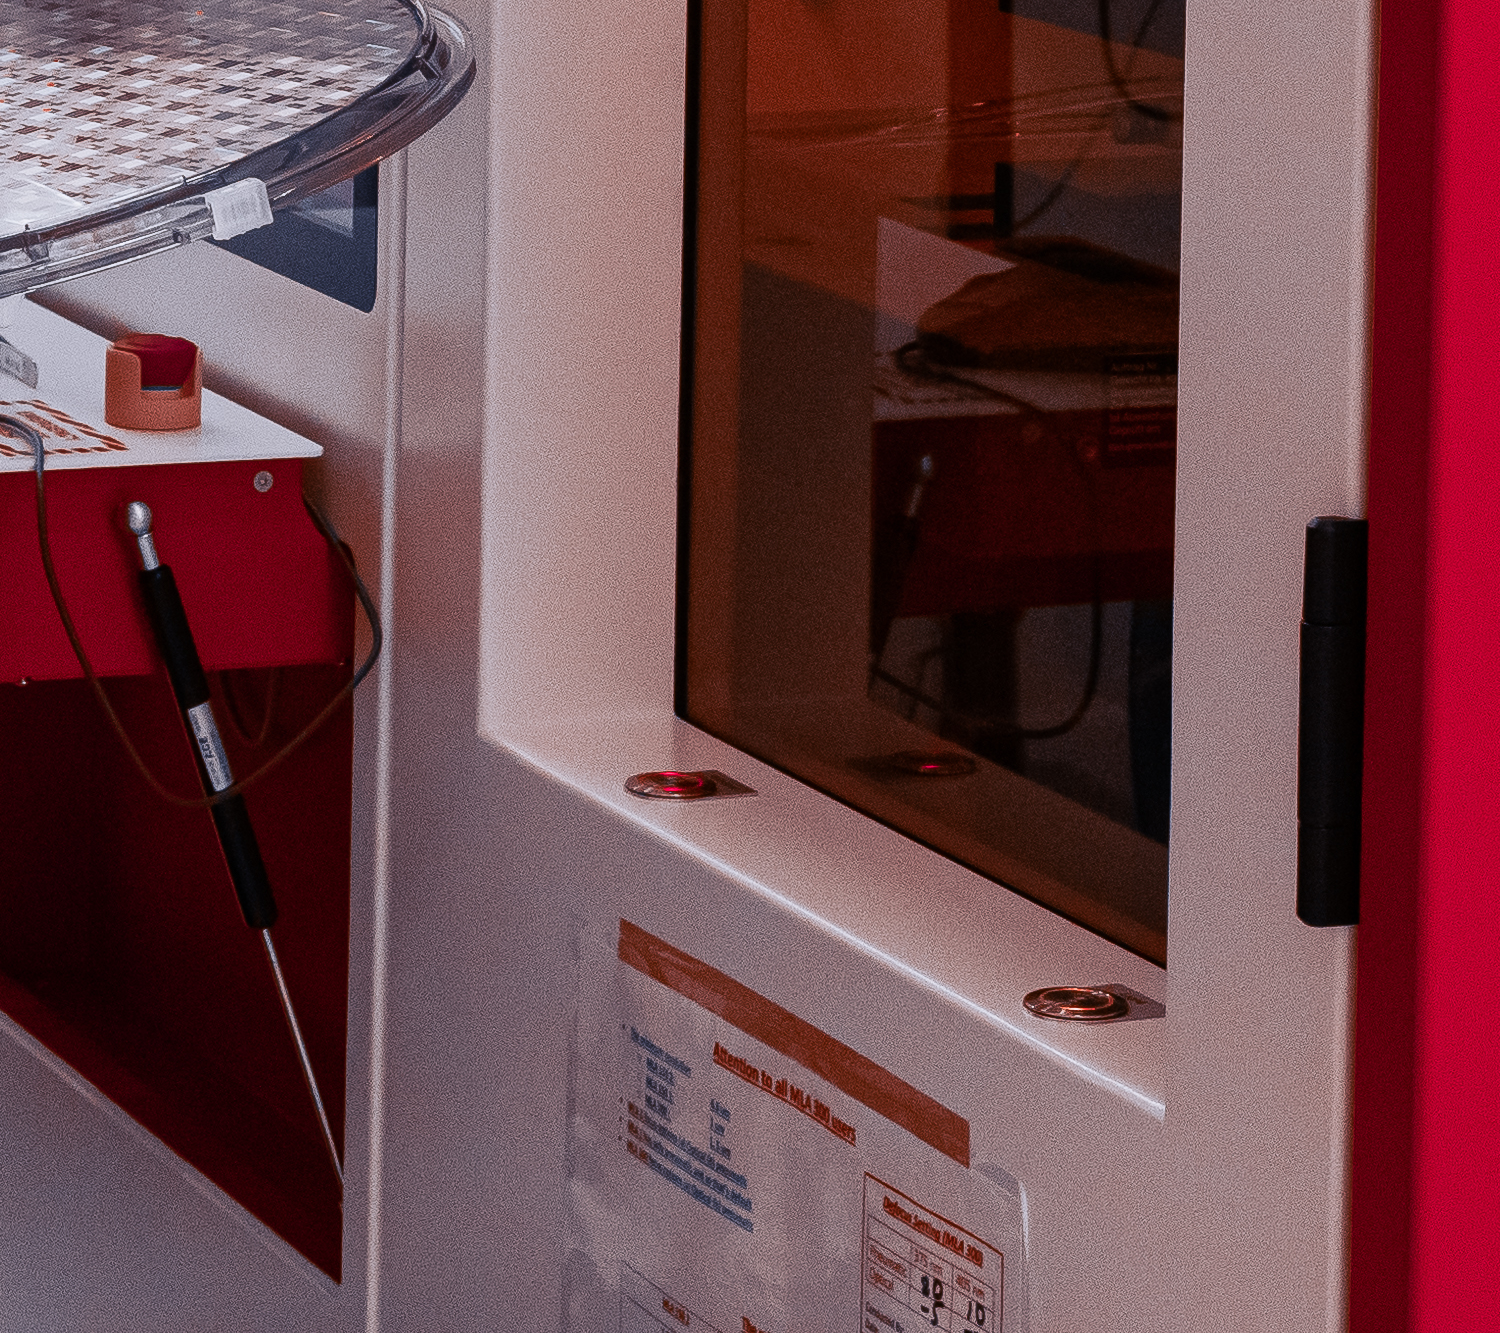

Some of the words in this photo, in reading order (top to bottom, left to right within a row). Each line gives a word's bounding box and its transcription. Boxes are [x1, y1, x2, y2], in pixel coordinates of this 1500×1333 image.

[713, 1041, 759, 1082] Attention
[761, 1070, 773, 1089] to
[775, 1078, 788, 1098] all
[790, 1085, 812, 1112] MLA
[832, 1116, 857, 1142] users
